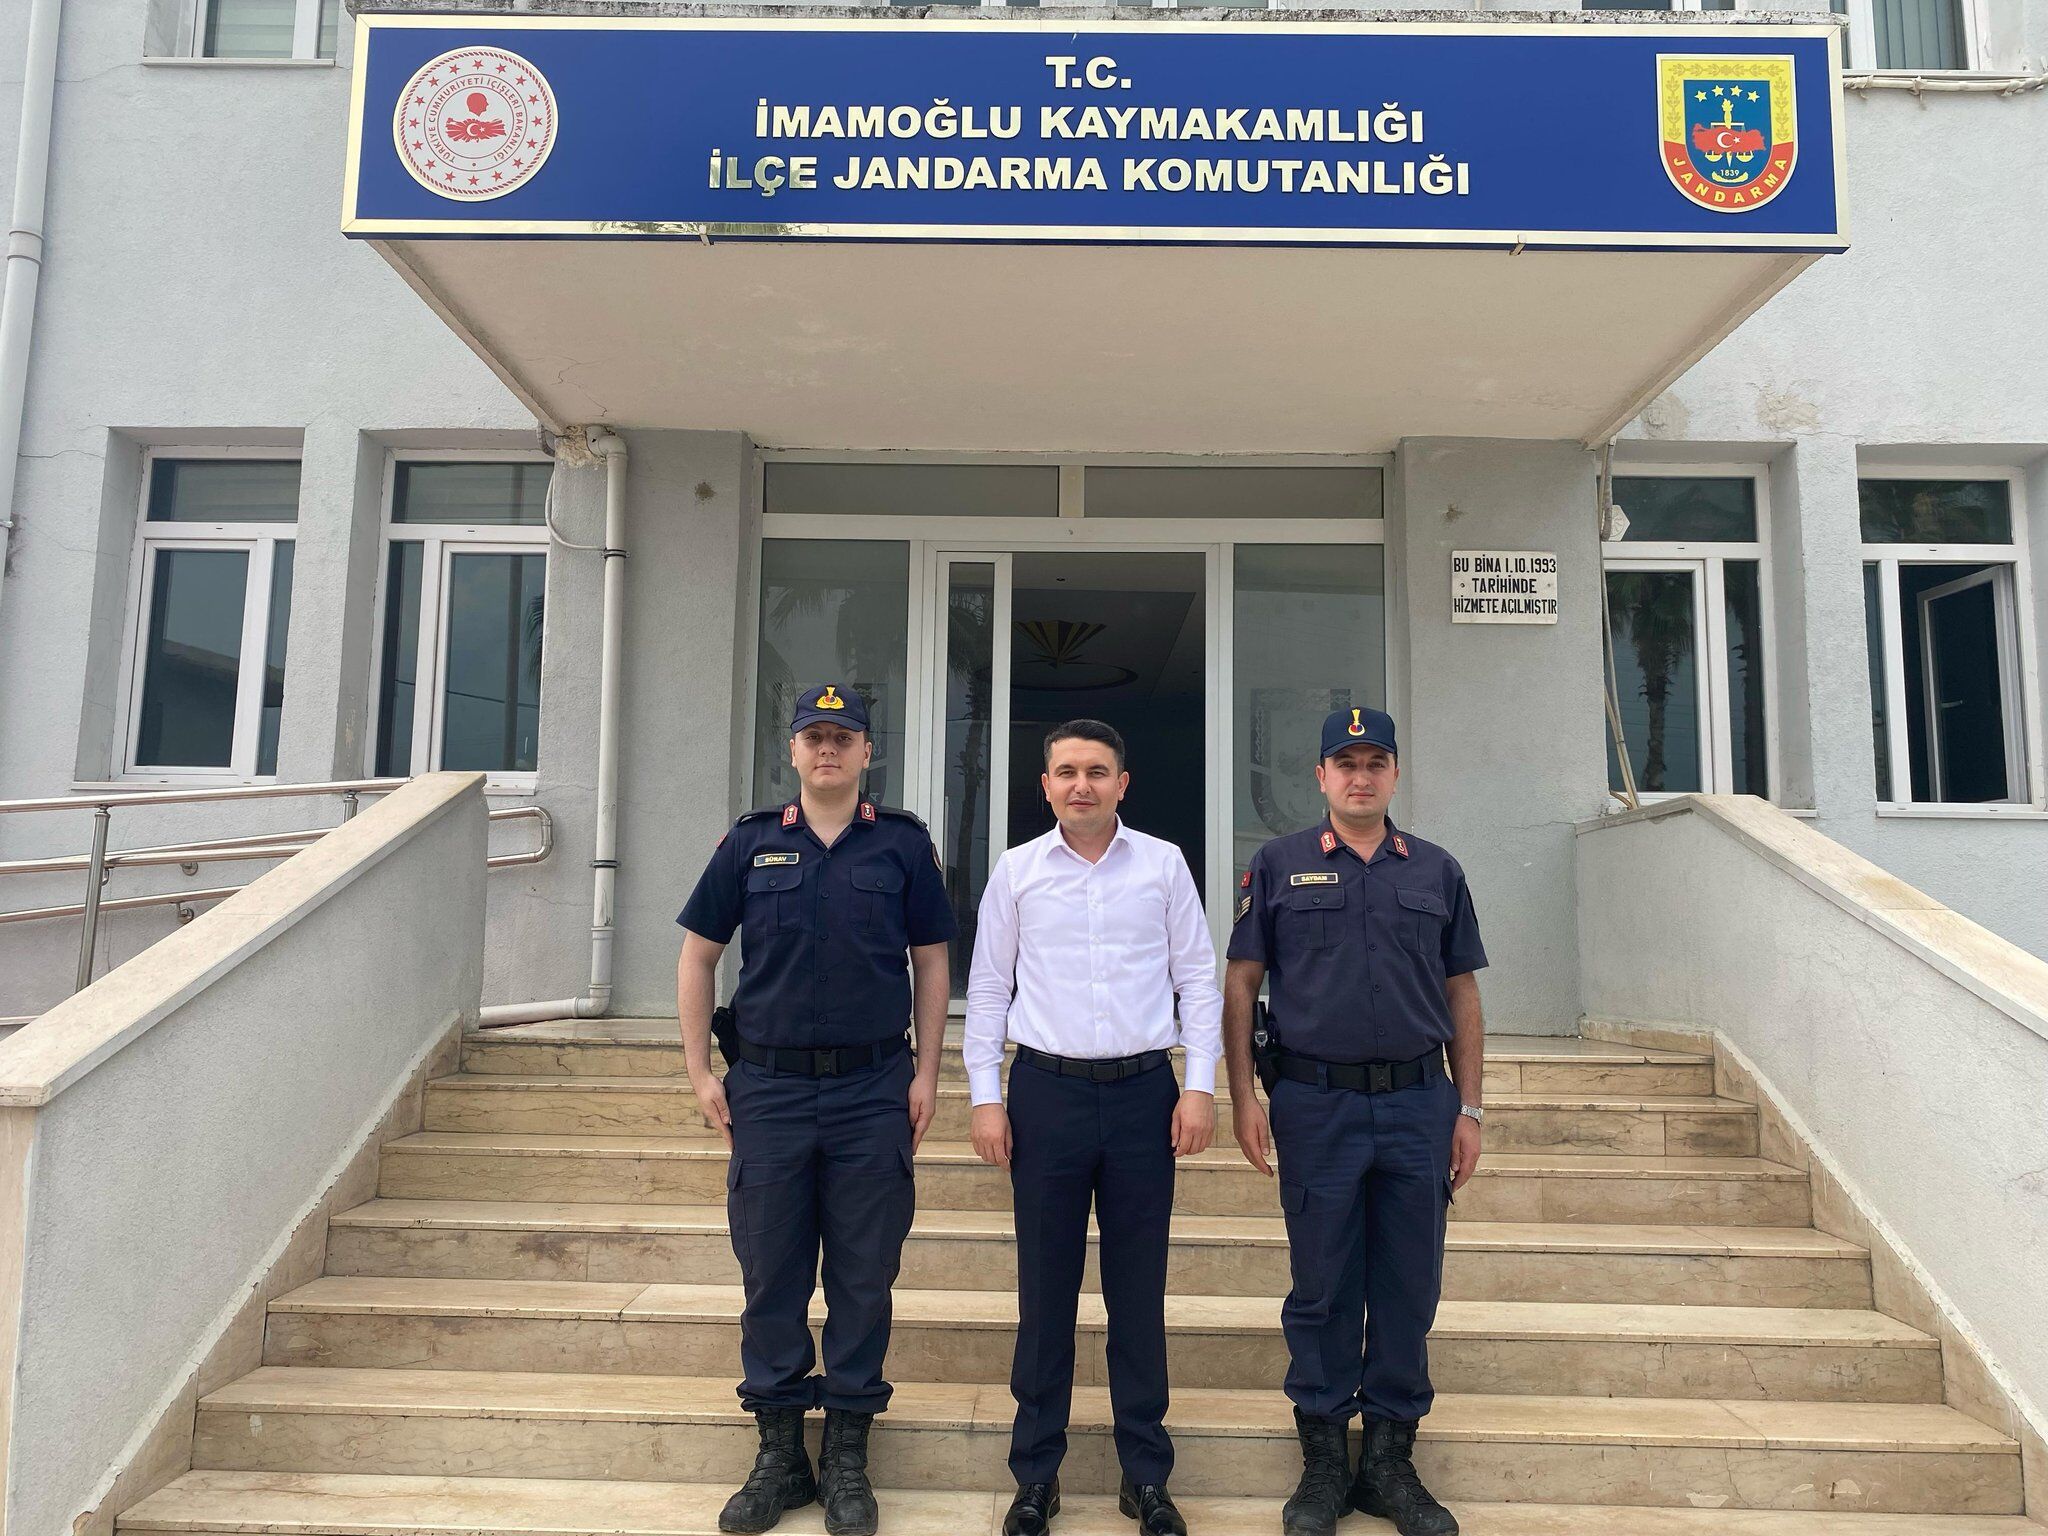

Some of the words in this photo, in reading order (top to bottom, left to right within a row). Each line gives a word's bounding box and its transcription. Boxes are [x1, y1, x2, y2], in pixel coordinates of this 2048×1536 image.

[1045, 56, 1132, 89] T.C.
[429, 76, 484, 123] CUMHURİYETİ
[487, 76, 522, 109] İÇİŞLERİ
[493, 111, 524, 162] BAKANLIĞI
[755, 97, 1022, 139] İMAMOĞLU
[1040, 101, 1424, 143] KAYMAKAMLIĞI
[709, 148, 818, 197] İLÇE
[832, 156, 1109, 190] JANDARMA
[1123, 153, 1469, 195] KOMUTANLIĞI
[1673, 158, 1787, 204] JANDARMA
[1719, 169, 1740, 177] 1839
[1453, 557, 1469, 573] BU
[1474, 554, 1502, 573] BİNA
[1472, 574, 1537, 594] TARİHİNDE
[1453, 595, 1499, 614] HİZMETE
[1500, 598, 1557, 615] AÇILMIŞTIR
